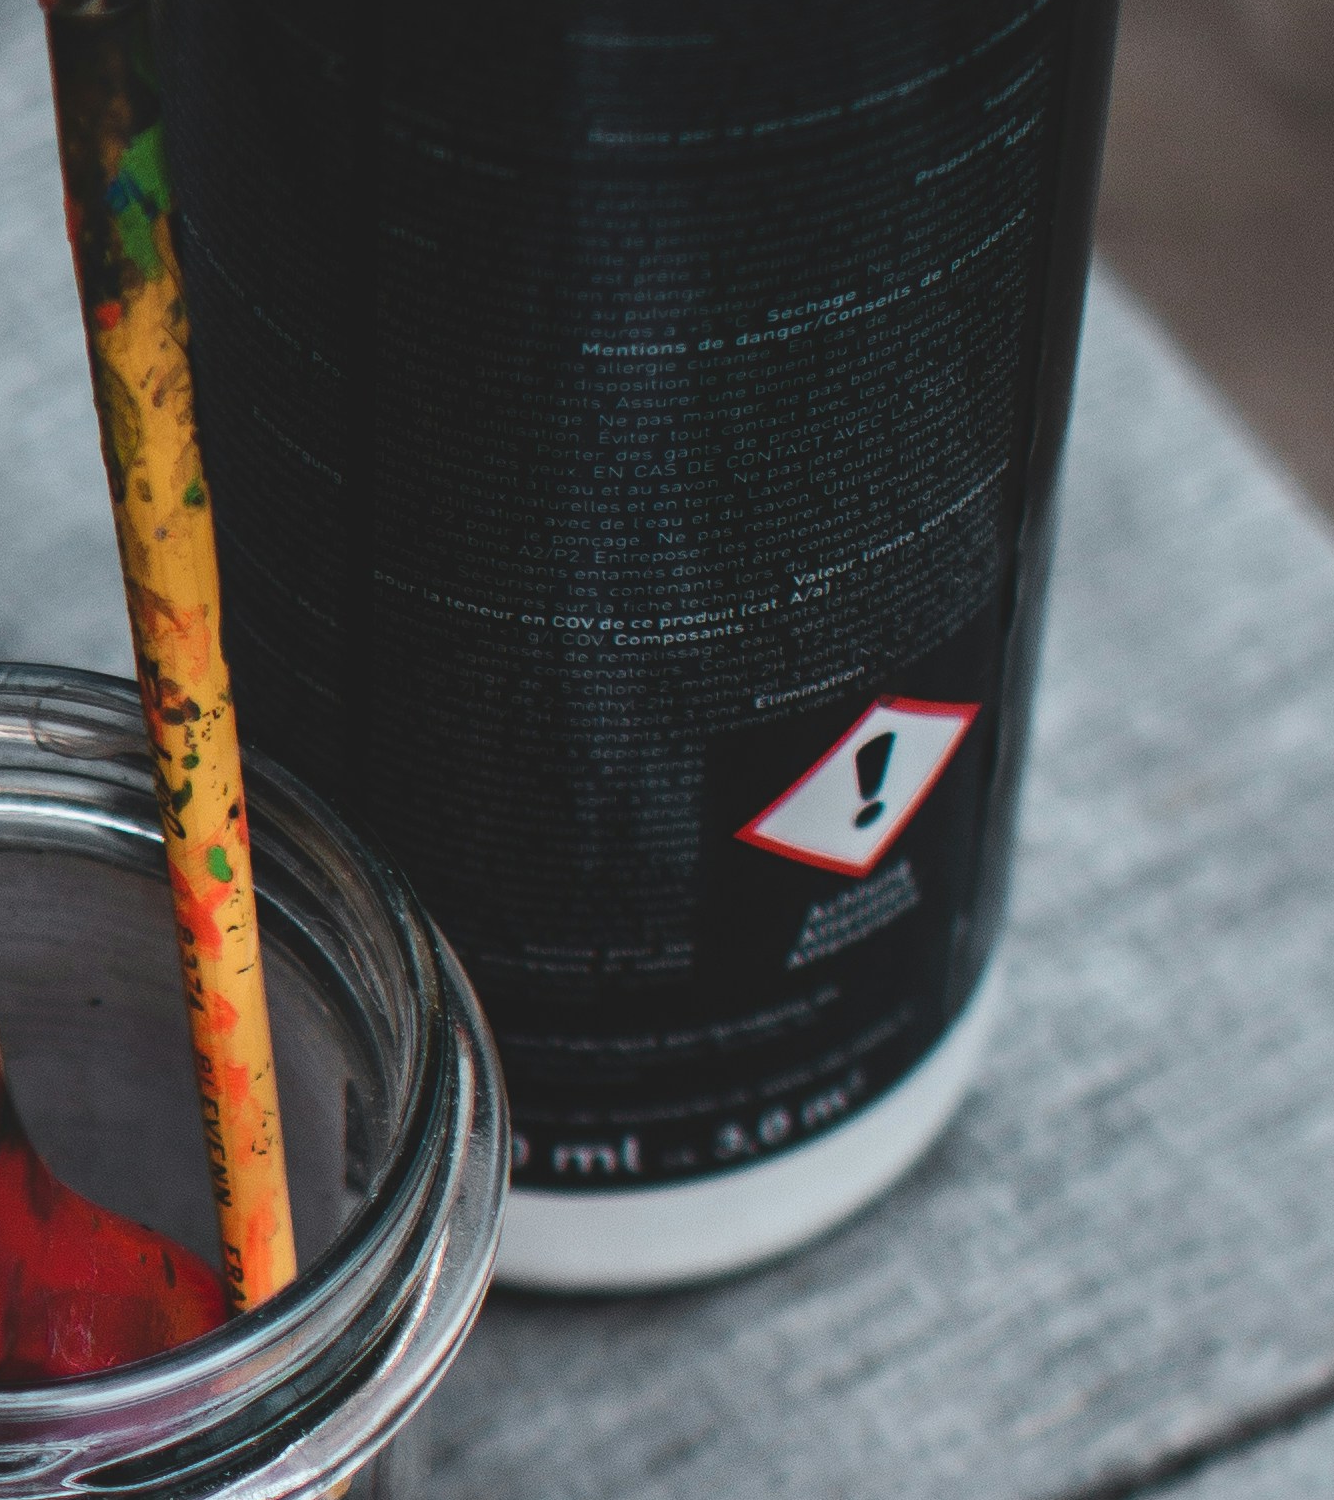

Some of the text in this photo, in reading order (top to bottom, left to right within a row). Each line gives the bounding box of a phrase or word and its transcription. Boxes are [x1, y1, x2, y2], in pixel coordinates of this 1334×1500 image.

[582, 208, 1027, 357] Mentions de danger/Conseils de prudence
[574, 378, 690, 395] disposition
[596, 361, 677, 376] allergie
[599, 414, 627, 428] Ne
[637, 414, 674, 429] pas
[808, 382, 842, 401] pas
[851, 360, 897, 386] boire
[616, 397, 700, 409] Assurer
[708, 388, 746, 402] une
[755, 372, 816, 396] bonne
[599, 383, 887, 444] Éviter tout contact avec les
[537, 444, 605, 461] Porter
[616, 450, 653, 461] des
[664, 444, 722, 462] gants
[734, 438, 757, 450] de
[594, 466, 624, 479] EN
[635, 464, 677, 478] CAS
[688, 459, 716, 474] DE
[726, 435, 824, 469] CONTACT
[833, 414, 883, 443] AVEC
[892, 401, 914, 419] LA
[601, 485, 620, 497] et
[628, 485, 652, 496] au
[733, 470, 761, 484] Ne
[768, 461, 802, 481] pas
[859, 432, 886, 450] les
[514, 494, 621, 514] naturelles
[627, 502, 646, 513] et
[653, 500, 678, 511] en
[747, 477, 804, 500] Laver
[810, 467, 837, 484] les
[544, 517, 591, 529] avec
[600, 517, 625, 530] de
[692, 513, 710, 524] et
[720, 509, 743, 521] du
[658, 532, 686, 544] Ne
[698, 527, 733, 543] pas
[744, 505, 824, 533] respirer
[833, 493, 859, 509] les
[594, 549, 712, 564] Entreposer
[718, 541, 746, 554] les
[672, 558, 745, 577] doivent
[793, 558, 858, 586] Valeur
[863, 531, 915, 562] limite
[373, 569, 417, 594] pour
[423, 587, 440, 603] la
[445, 595, 515, 620] teneur
[520, 613, 546, 626] en
[552, 616, 595, 629] COV
[599, 618, 625, 630] de
[630, 619, 653, 629] ce
[660, 607, 734, 630] produit
[568, 585, 598, 597] les
[609, 579, 723, 597] contenants
[615, 624, 745, 646] Composants
